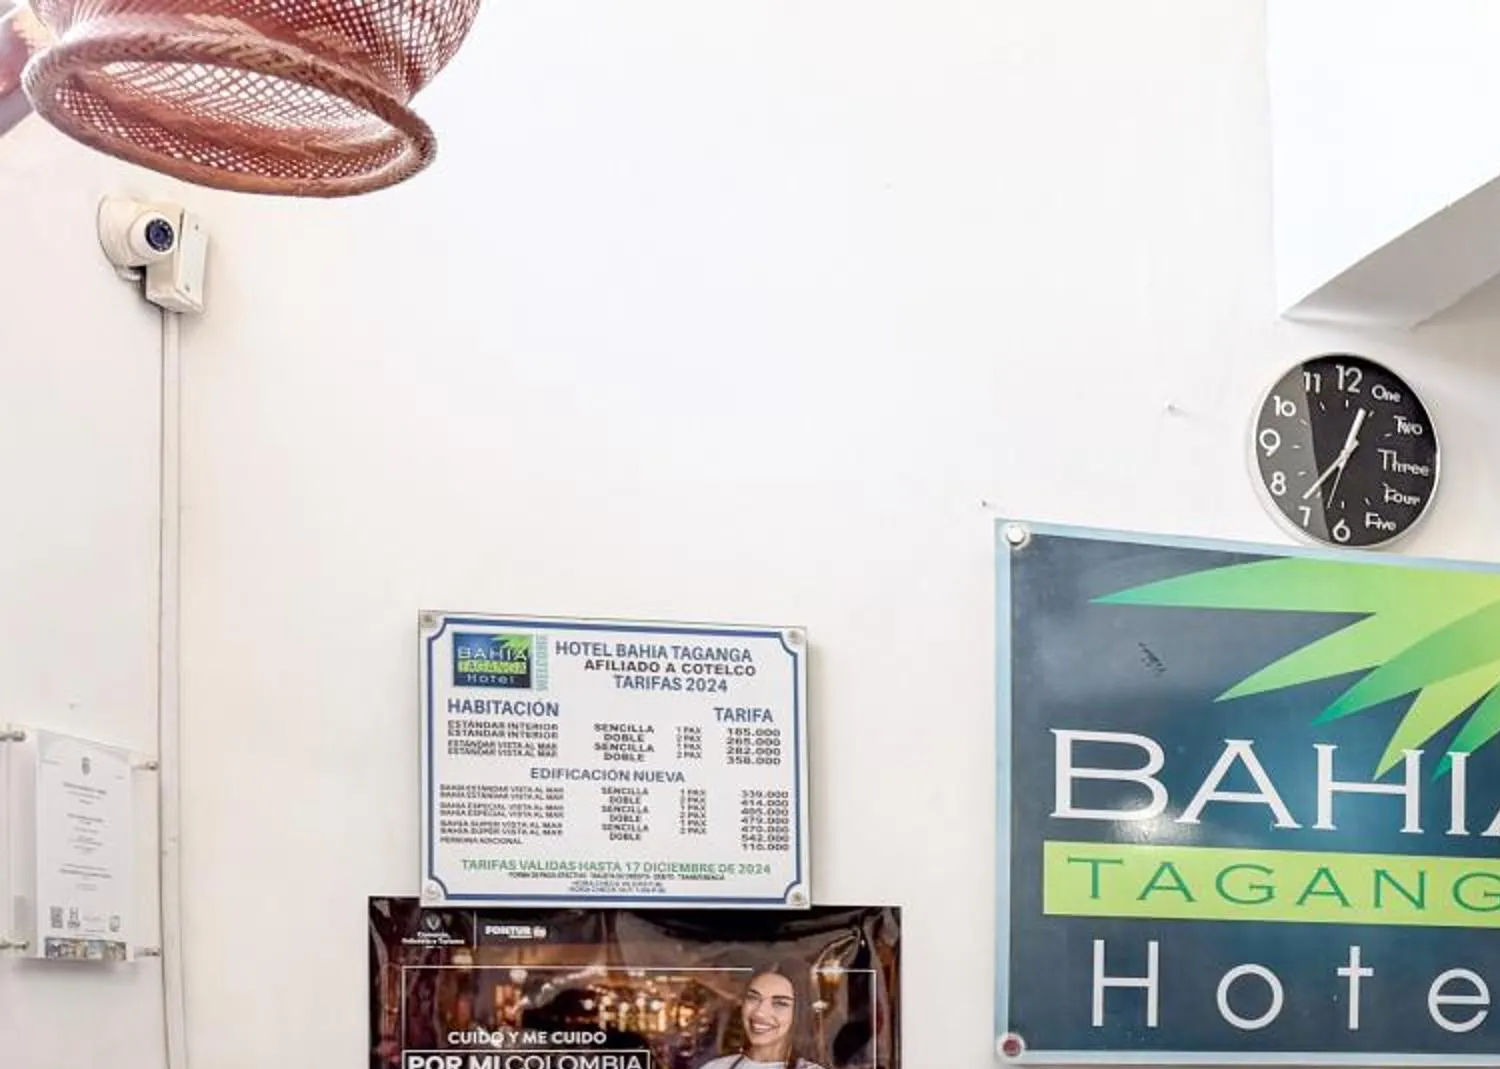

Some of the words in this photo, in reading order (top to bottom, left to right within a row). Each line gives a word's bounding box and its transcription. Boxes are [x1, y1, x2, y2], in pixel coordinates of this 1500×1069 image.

[1303, 372, 1321, 393] 11
[1335, 365, 1363, 393] 12
[1371, 385, 1401, 403] One
[1273, 396, 1296, 416] 10
[1393, 415, 1423, 435] Two
[1259, 429, 1281, 457] 9
[1378, 449, 1429, 477] Three
[1270, 472, 1286, 496] 8
[1383, 483, 1420, 505] Four
[1300, 506, 1311, 527] 7
[1365, 512, 1396, 531] Five
[1333, 519, 1350, 541] 6
[555, 641, 612, 657] HOTEL
[616, 643, 668, 660] BAHIA
[671, 646, 752, 663] TAGANGA
[584, 660, 660, 673] AFILIADO
[665, 662, 676, 673] A
[682, 663, 756, 676] COTELCO
[614, 675, 682, 691] TARIFAS
[686, 678, 728, 693] 2024
[714, 707, 774, 723] TARIFA
[593, 723, 655, 733] SENCILLA
[604, 733, 645, 743] DOBLE
[594, 742, 655, 753] SENCILLA
[604, 752, 645, 762] DOBLE
[633, 770, 686, 783] NUEVA
[601, 787, 649, 795] SENCILLA
[609, 796, 640, 804] DOBLE
[601, 805, 649, 814] SENCILLA
[609, 814, 640, 822] DOBLE
[601, 823, 649, 832] SENCILLA
[609, 833, 641, 841] DOBLE
[462, 859, 516, 870] TARIFAS
[579, 861, 621, 871] HASTA
[644, 863, 715, 873] DICIEMBRE
[718, 864, 736, 874] DE
[1091, 939, 1492, 1033] Hote
[448, 1032, 504, 1045] CUIDO
[509, 1032, 520, 1044] Y
[523, 1032, 548, 1044] ME
[552, 1031, 607, 1044] CUIDO
